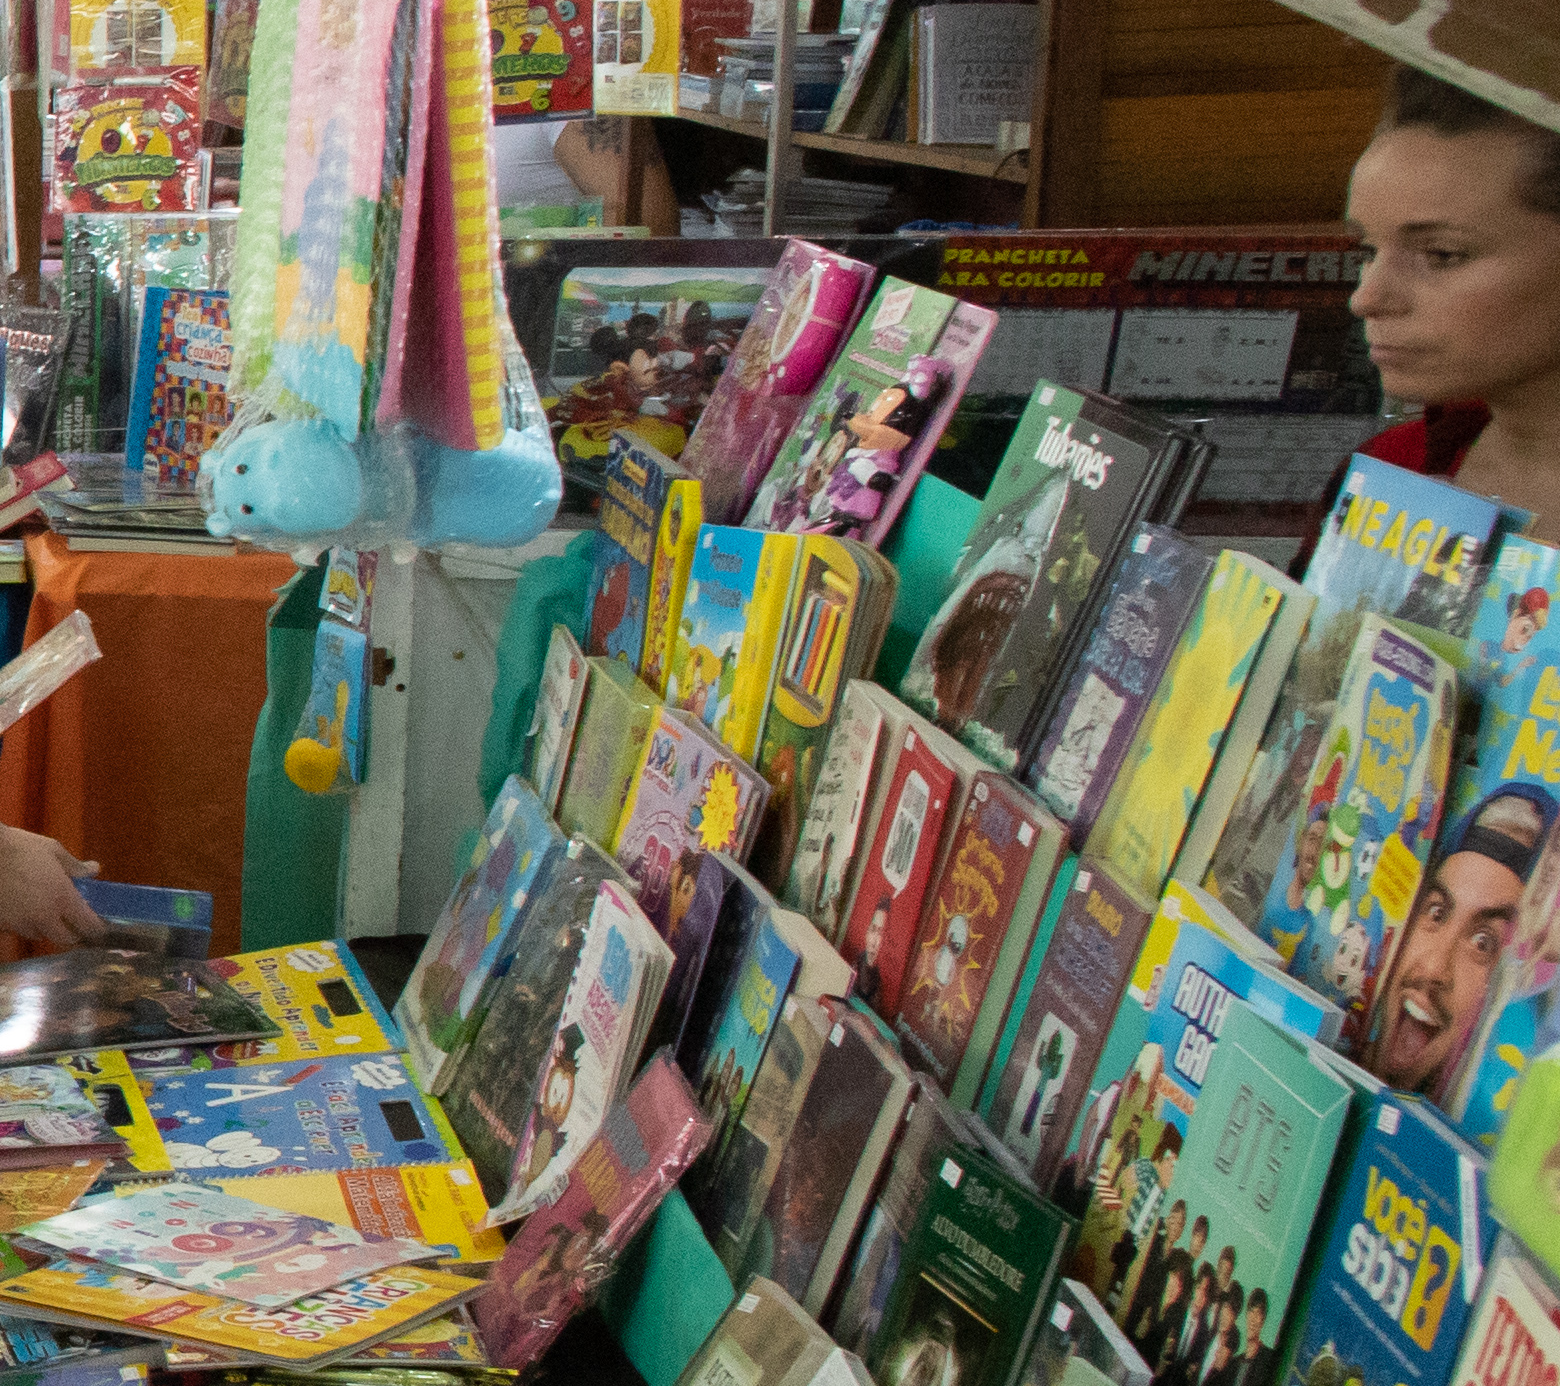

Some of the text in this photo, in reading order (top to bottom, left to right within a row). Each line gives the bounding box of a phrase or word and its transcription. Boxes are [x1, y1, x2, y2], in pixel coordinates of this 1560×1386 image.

[942, 248, 1090, 265] PRANCHETA
[937, 271, 1106, 289] ARA COLORIR
